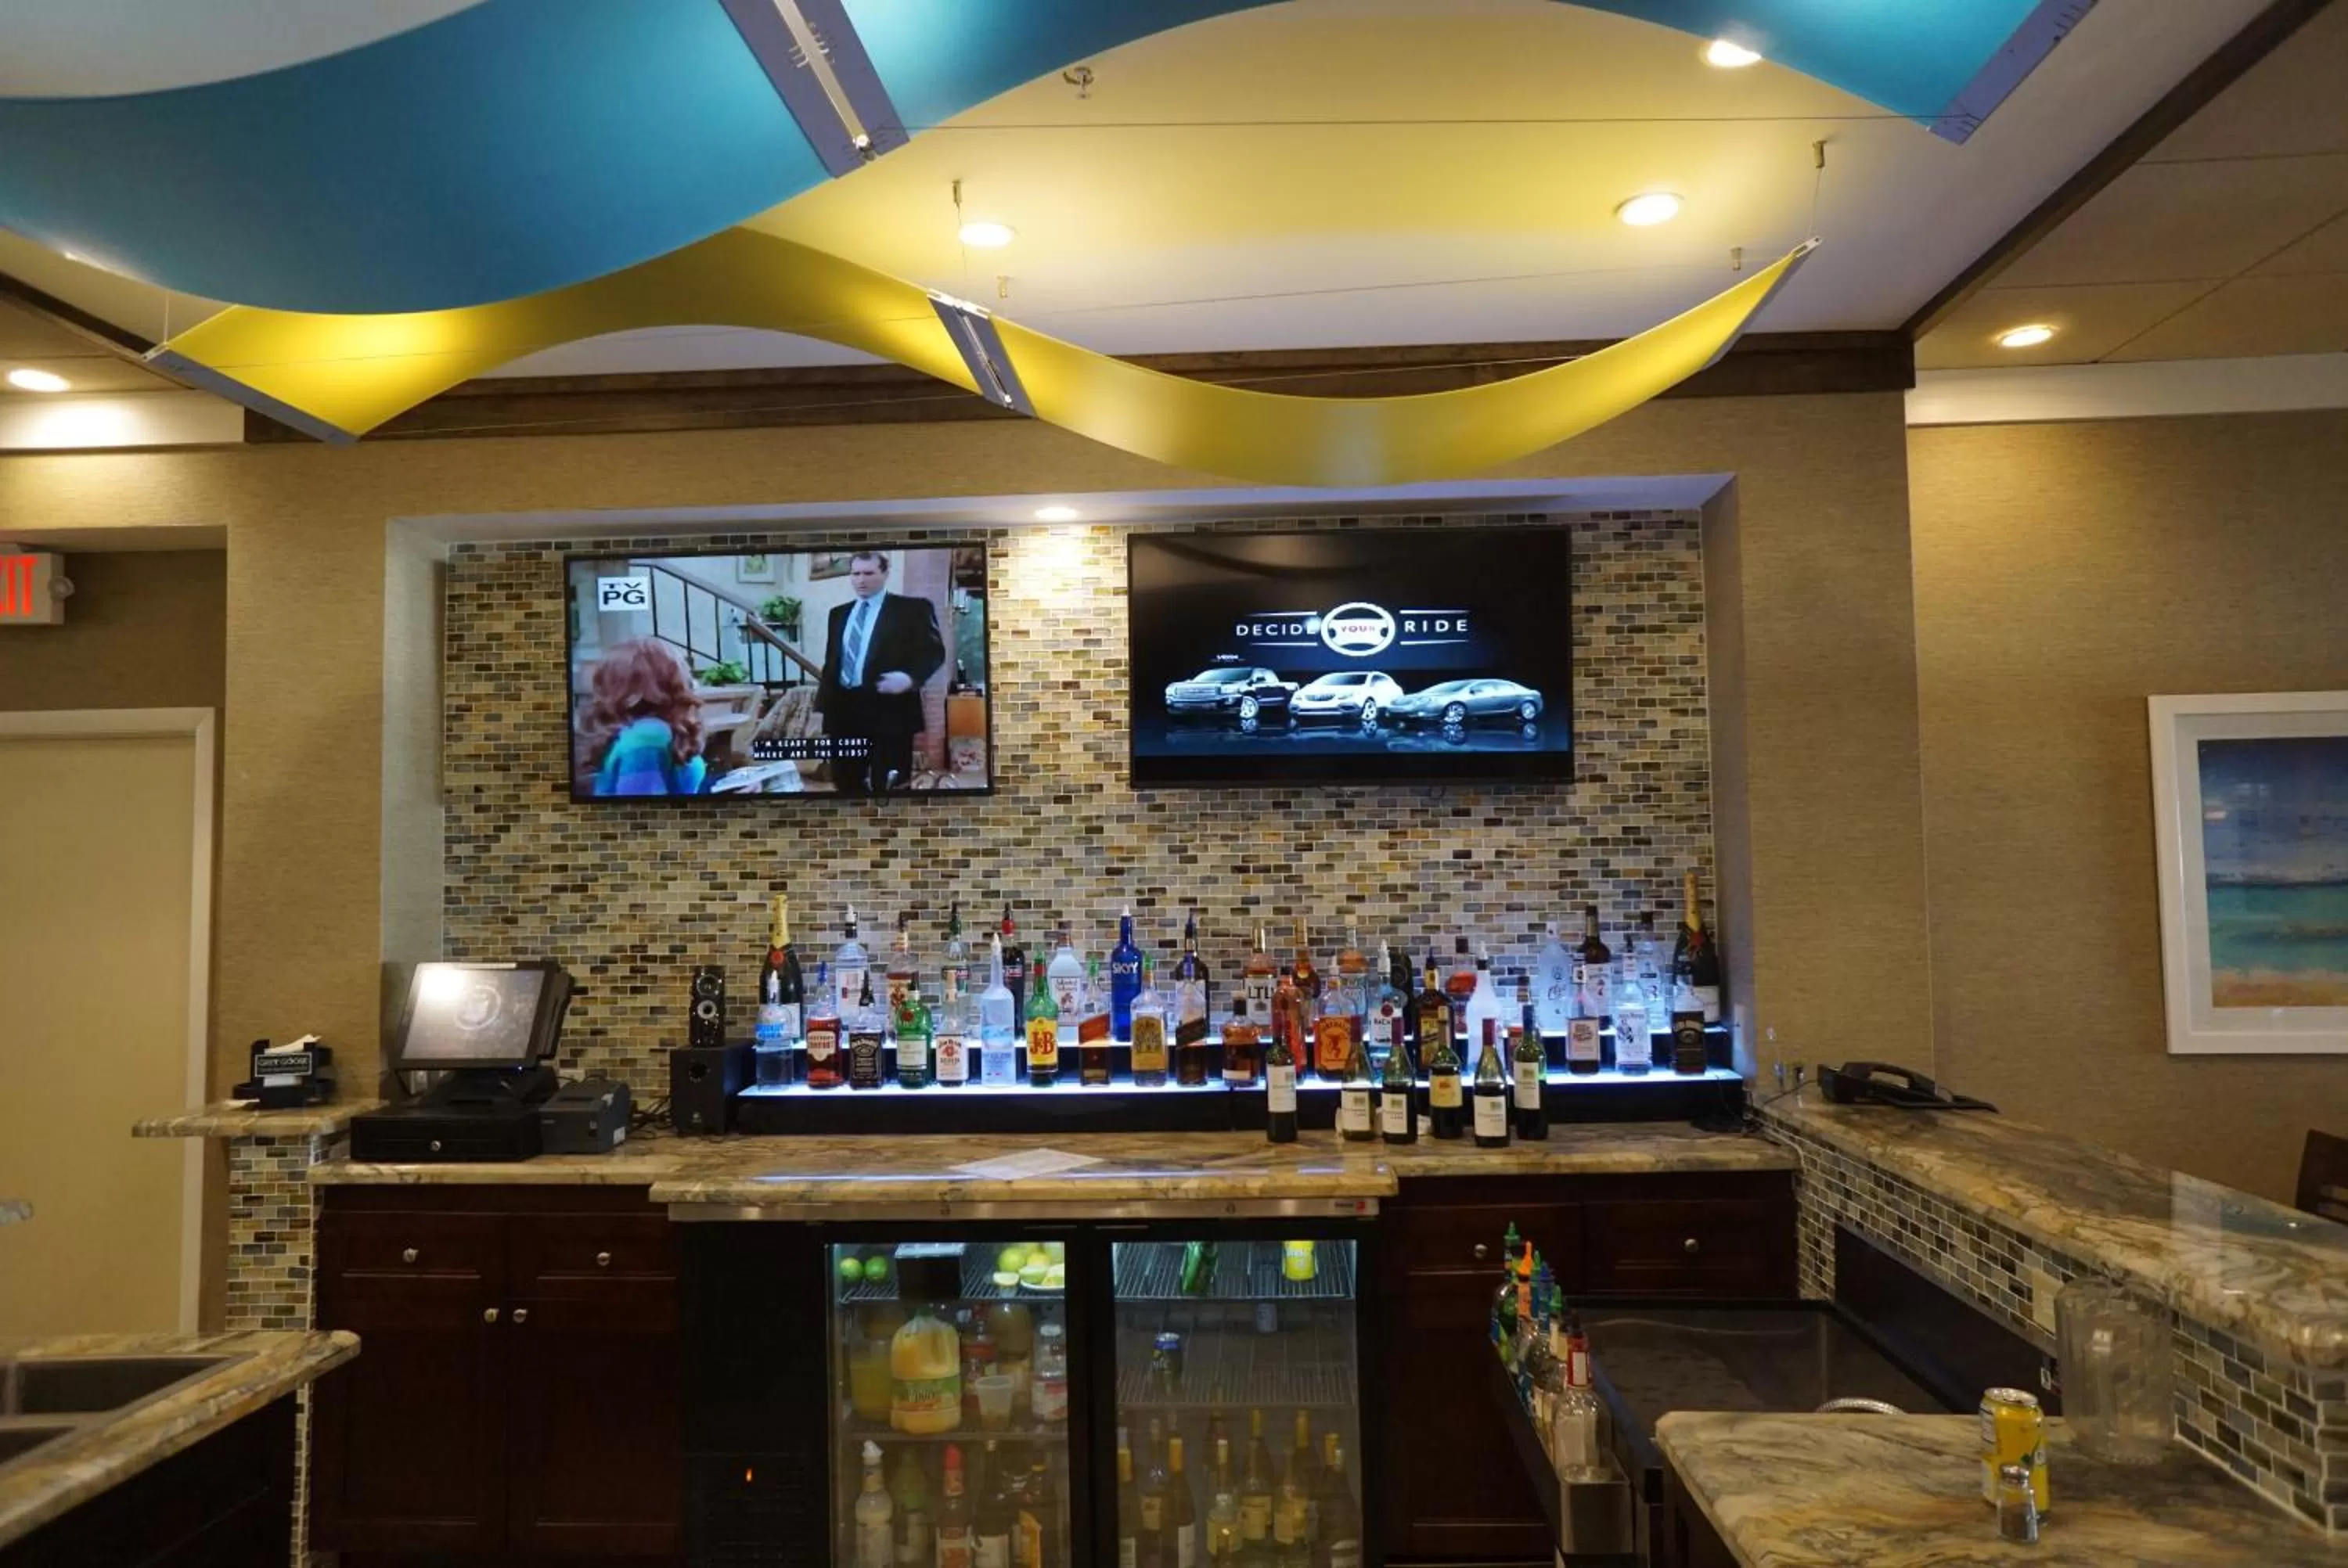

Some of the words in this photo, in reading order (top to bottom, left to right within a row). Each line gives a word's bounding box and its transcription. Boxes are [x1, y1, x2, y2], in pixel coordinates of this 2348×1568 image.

[603, 589, 646, 606] PG
[1236, 624, 1318, 636] DECIDE
[1404, 619, 1468, 633] RIDE
[1112, 962, 1139, 975] SKYY
[1029, 1030, 1054, 1056] J&B
